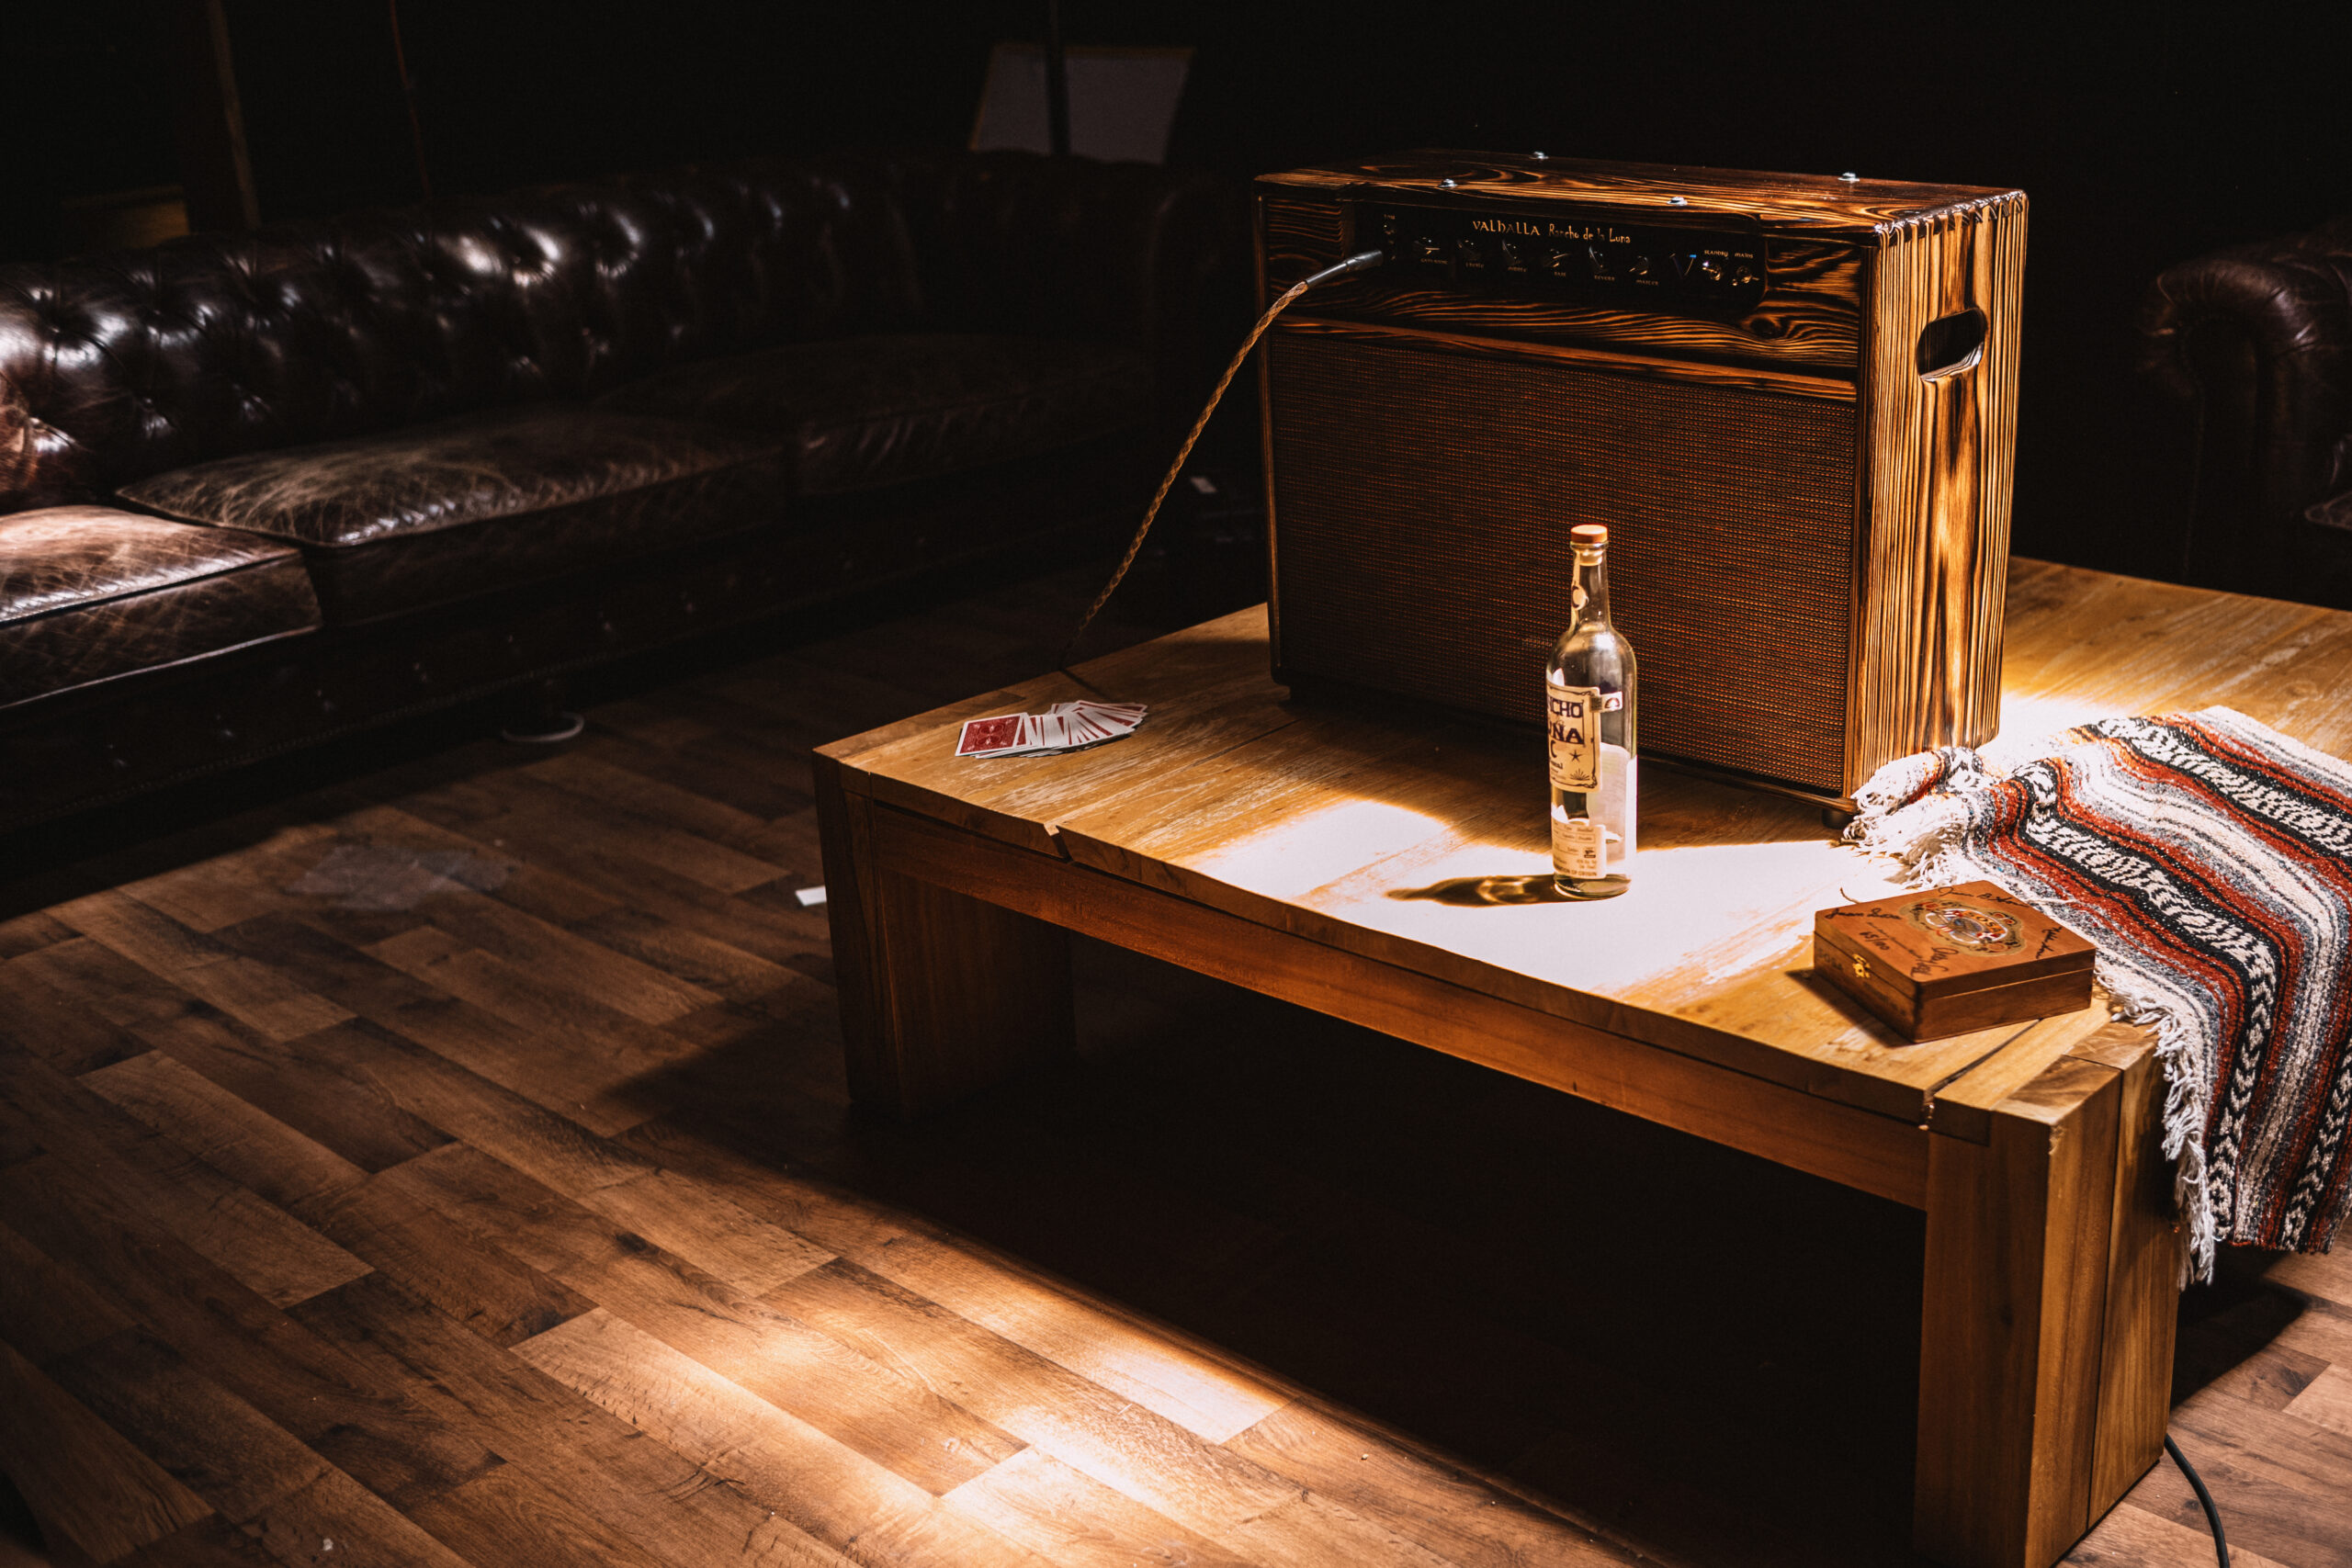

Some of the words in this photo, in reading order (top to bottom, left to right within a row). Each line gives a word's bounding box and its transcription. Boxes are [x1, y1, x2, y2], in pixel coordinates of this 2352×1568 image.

[1582, 227, 1594, 241] de
[1609, 228, 1631, 243] Luna
[1550, 697, 1583, 718] CHO
